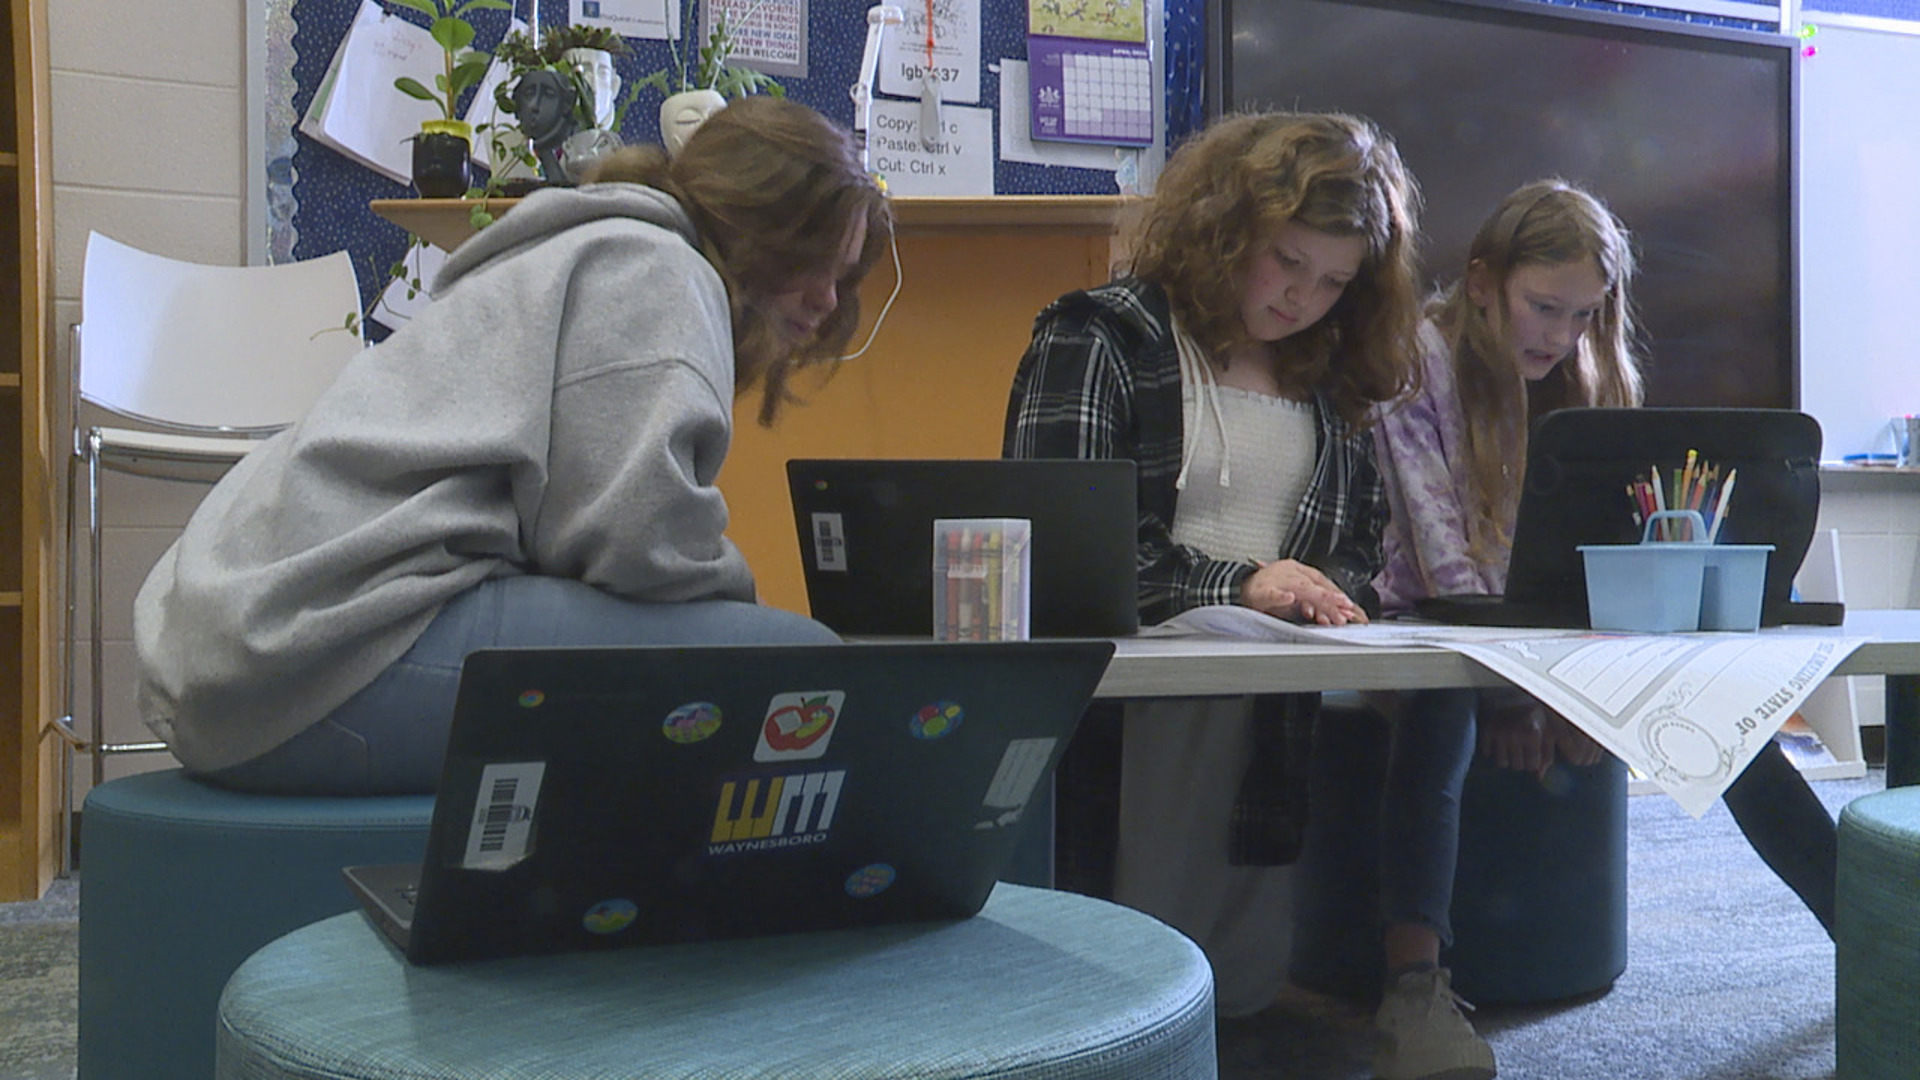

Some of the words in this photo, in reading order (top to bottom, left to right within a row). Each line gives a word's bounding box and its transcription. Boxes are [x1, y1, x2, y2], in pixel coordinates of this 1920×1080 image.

[710, 8, 737, 18] SHRE
[764, 13, 798, 24] FRIENDS
[751, 28, 770, 37] NEW
[773, 31, 798, 40] IDEAS
[733, 46, 750, 56] ARE
[753, 49, 797, 60] WELCOME
[742, 38, 763, 46] NEW
[766, 40, 798, 50] THINGS
[876, 114, 917, 133] Copy:
[876, 135, 920, 152] Paste:
[953, 144, 962, 155] v
[877, 157, 905, 172] Cut:
[910, 159, 934, 174] Ctrl
[938, 166, 946, 176] x
[1754, 687, 1795, 720] STATE
[1733, 715, 1758, 736] OF
[708, 833, 827, 856] WAYNESBORO
